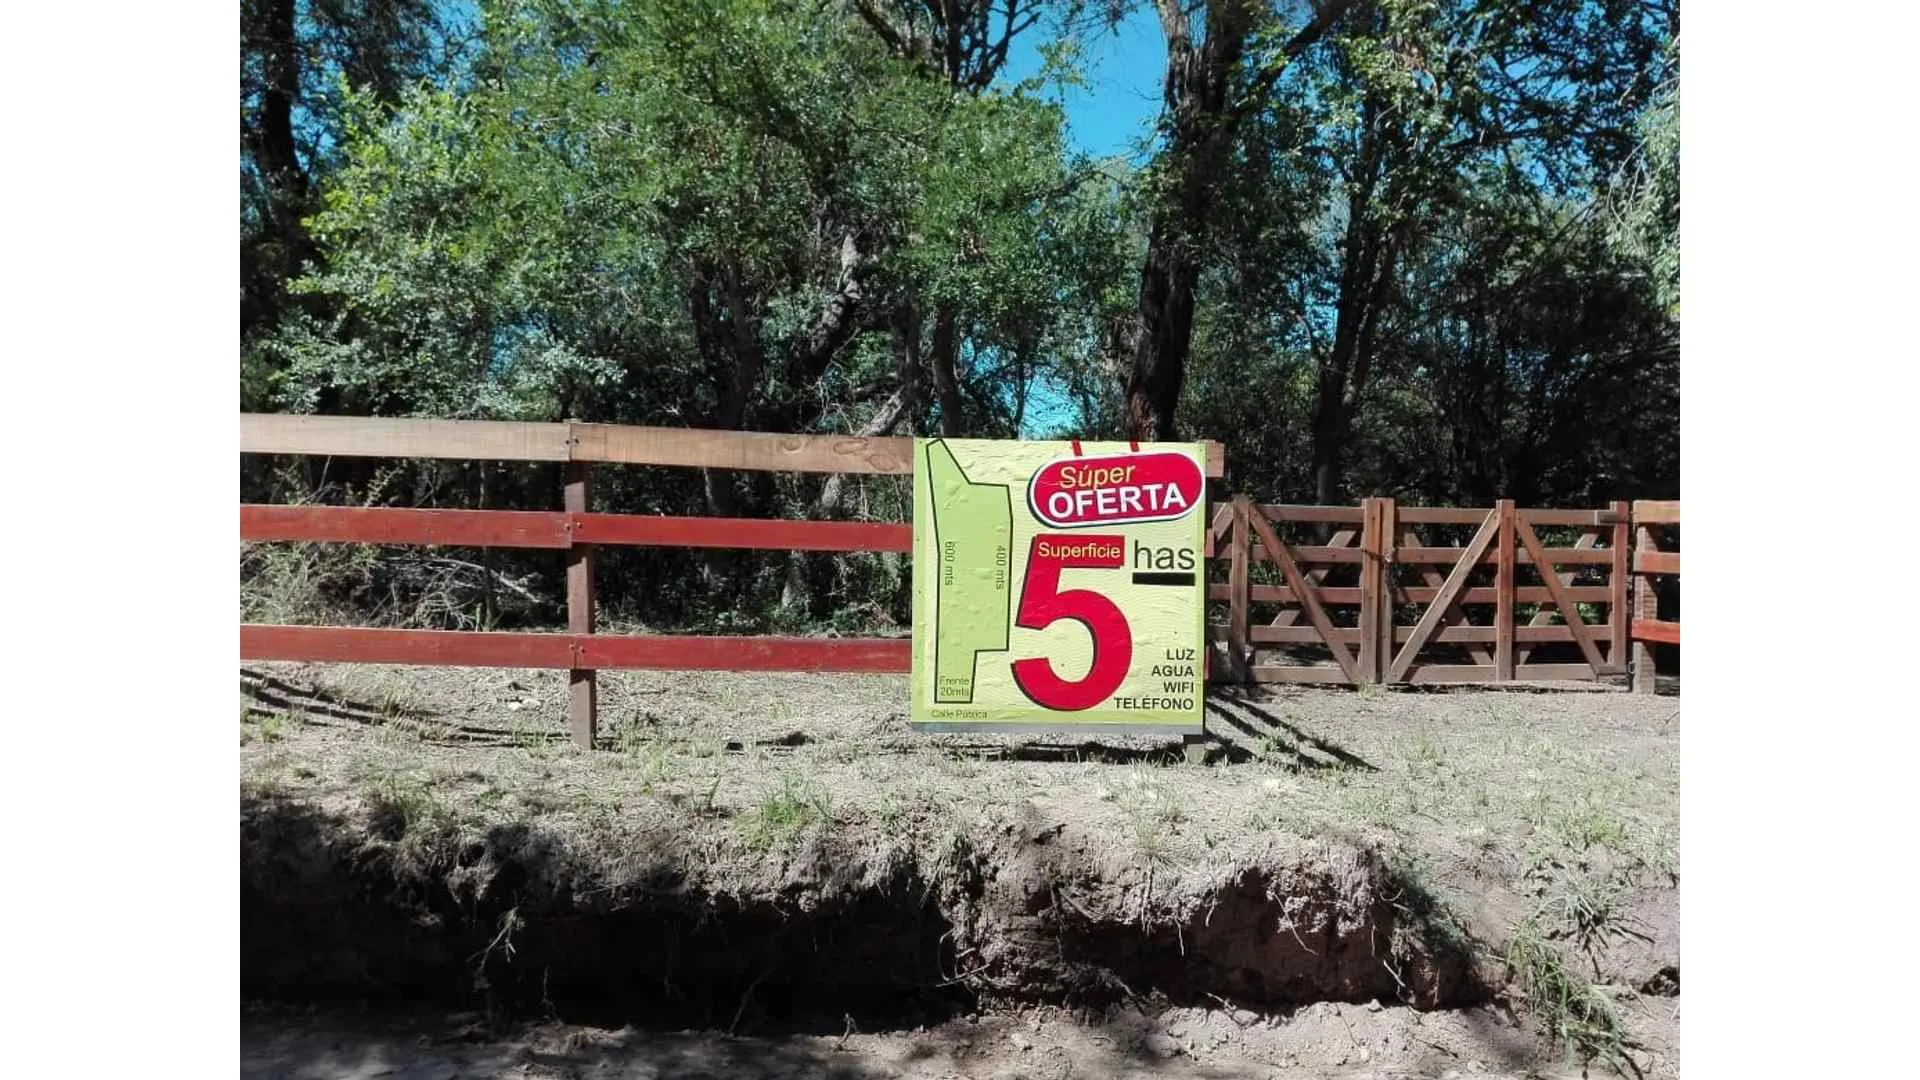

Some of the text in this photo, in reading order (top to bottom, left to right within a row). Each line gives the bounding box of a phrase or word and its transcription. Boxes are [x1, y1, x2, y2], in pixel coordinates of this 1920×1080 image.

[1060, 464, 1136, 490] Súper
[1048, 483, 1187, 518] OFERTA
[1038, 541, 1121, 560] Superficie
[1134, 539, 1195, 570] has
[944, 541, 956, 586] 600 mts
[996, 545, 1007, 590] 400 mts
[1010, 533, 1133, 712] 5
[1166, 649, 1195, 661] LUZ
[939, 675, 969, 686] Frente
[1151, 665, 1194, 678] AGUA
[1163, 681, 1194, 694] WIFI
[1115, 695, 1194, 710] TELÉFONO
